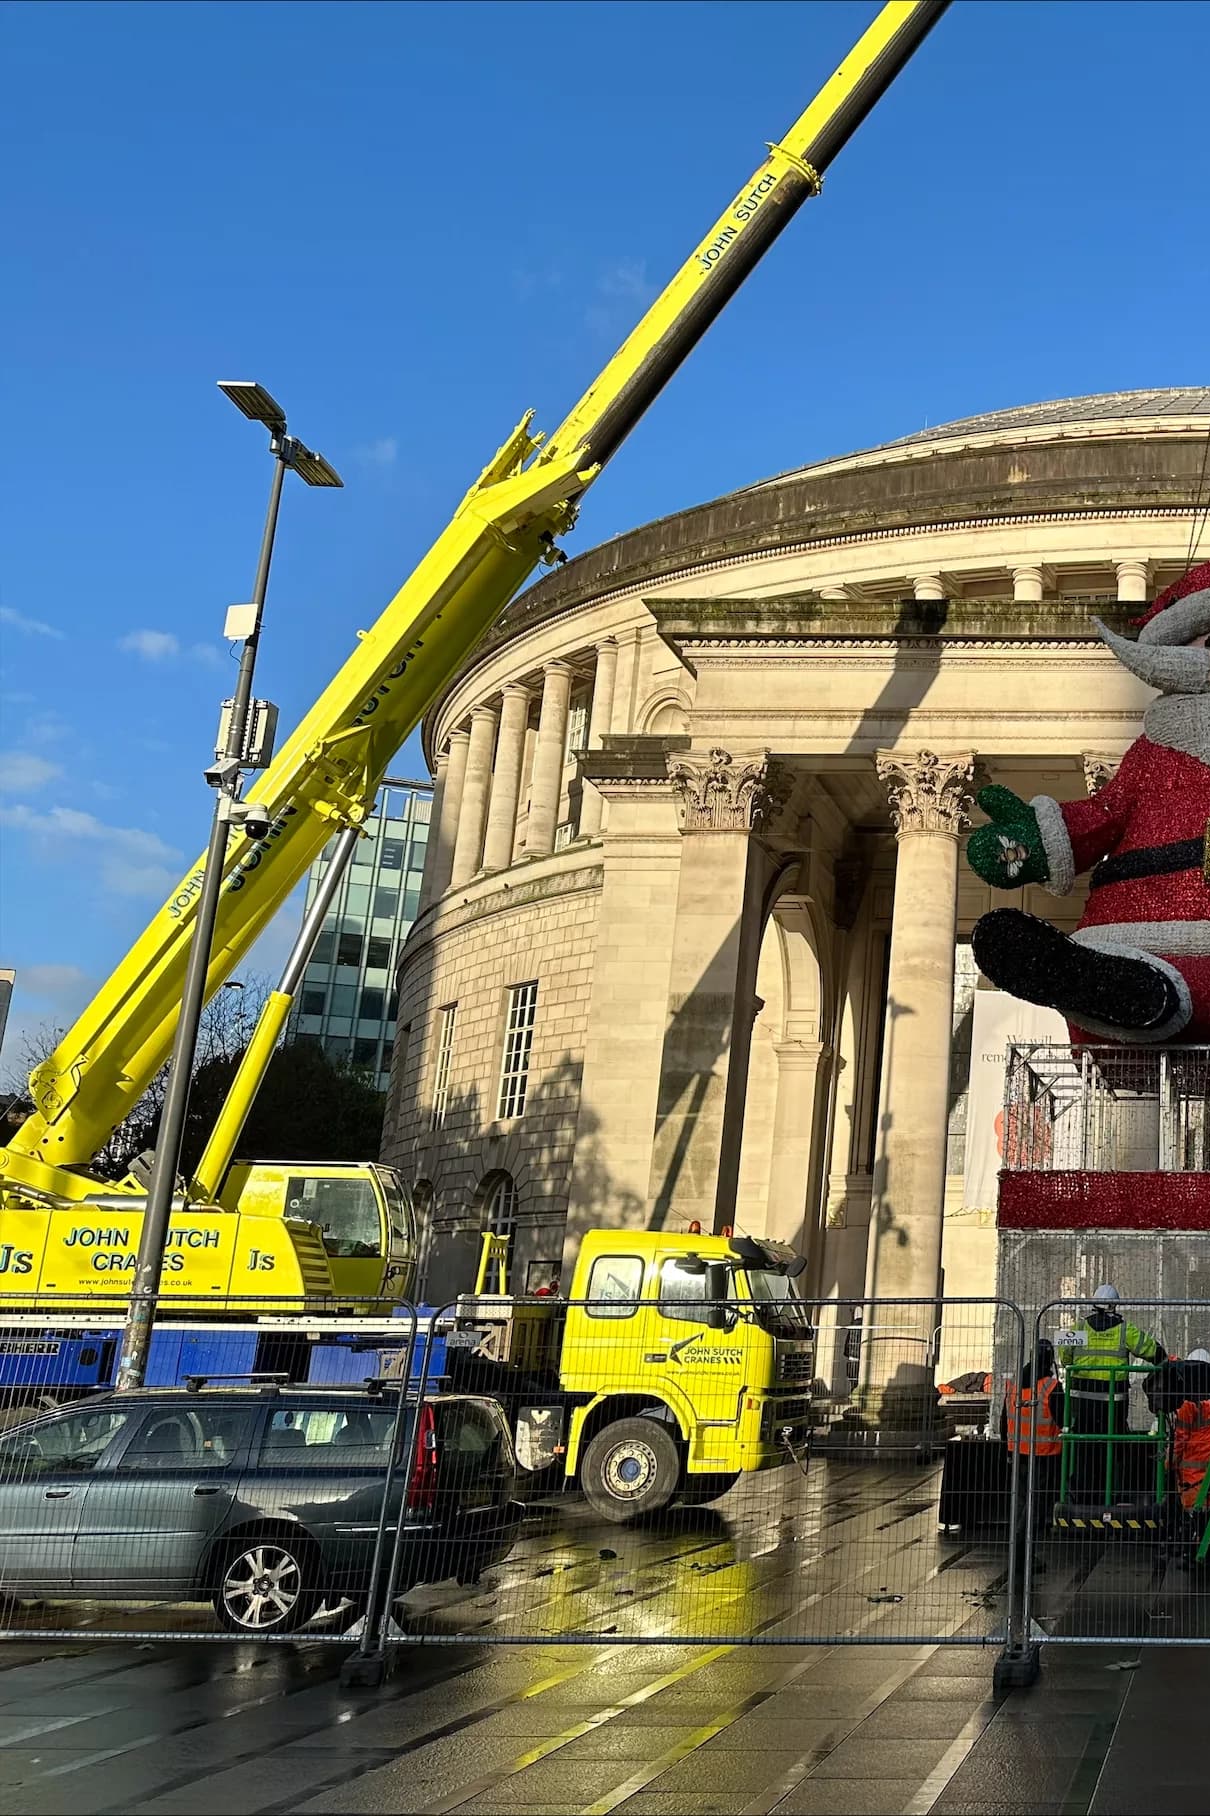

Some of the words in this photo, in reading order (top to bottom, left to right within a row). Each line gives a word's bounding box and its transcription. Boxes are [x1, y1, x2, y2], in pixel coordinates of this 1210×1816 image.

[701, 226, 738, 270] JOHN
[736, 173, 777, 222] SUTCH
[168, 869, 206, 919] JOHN
[63, 1228, 129, 1247] JOHN
[164, 1229, 220, 1248] UTCH
[92, 1252, 185, 1271] CRAES
[684, 1348, 711, 1356] JOHN
[712, 1348, 743, 1357] SUTCH
[684, 1356, 722, 1364] CRANES
